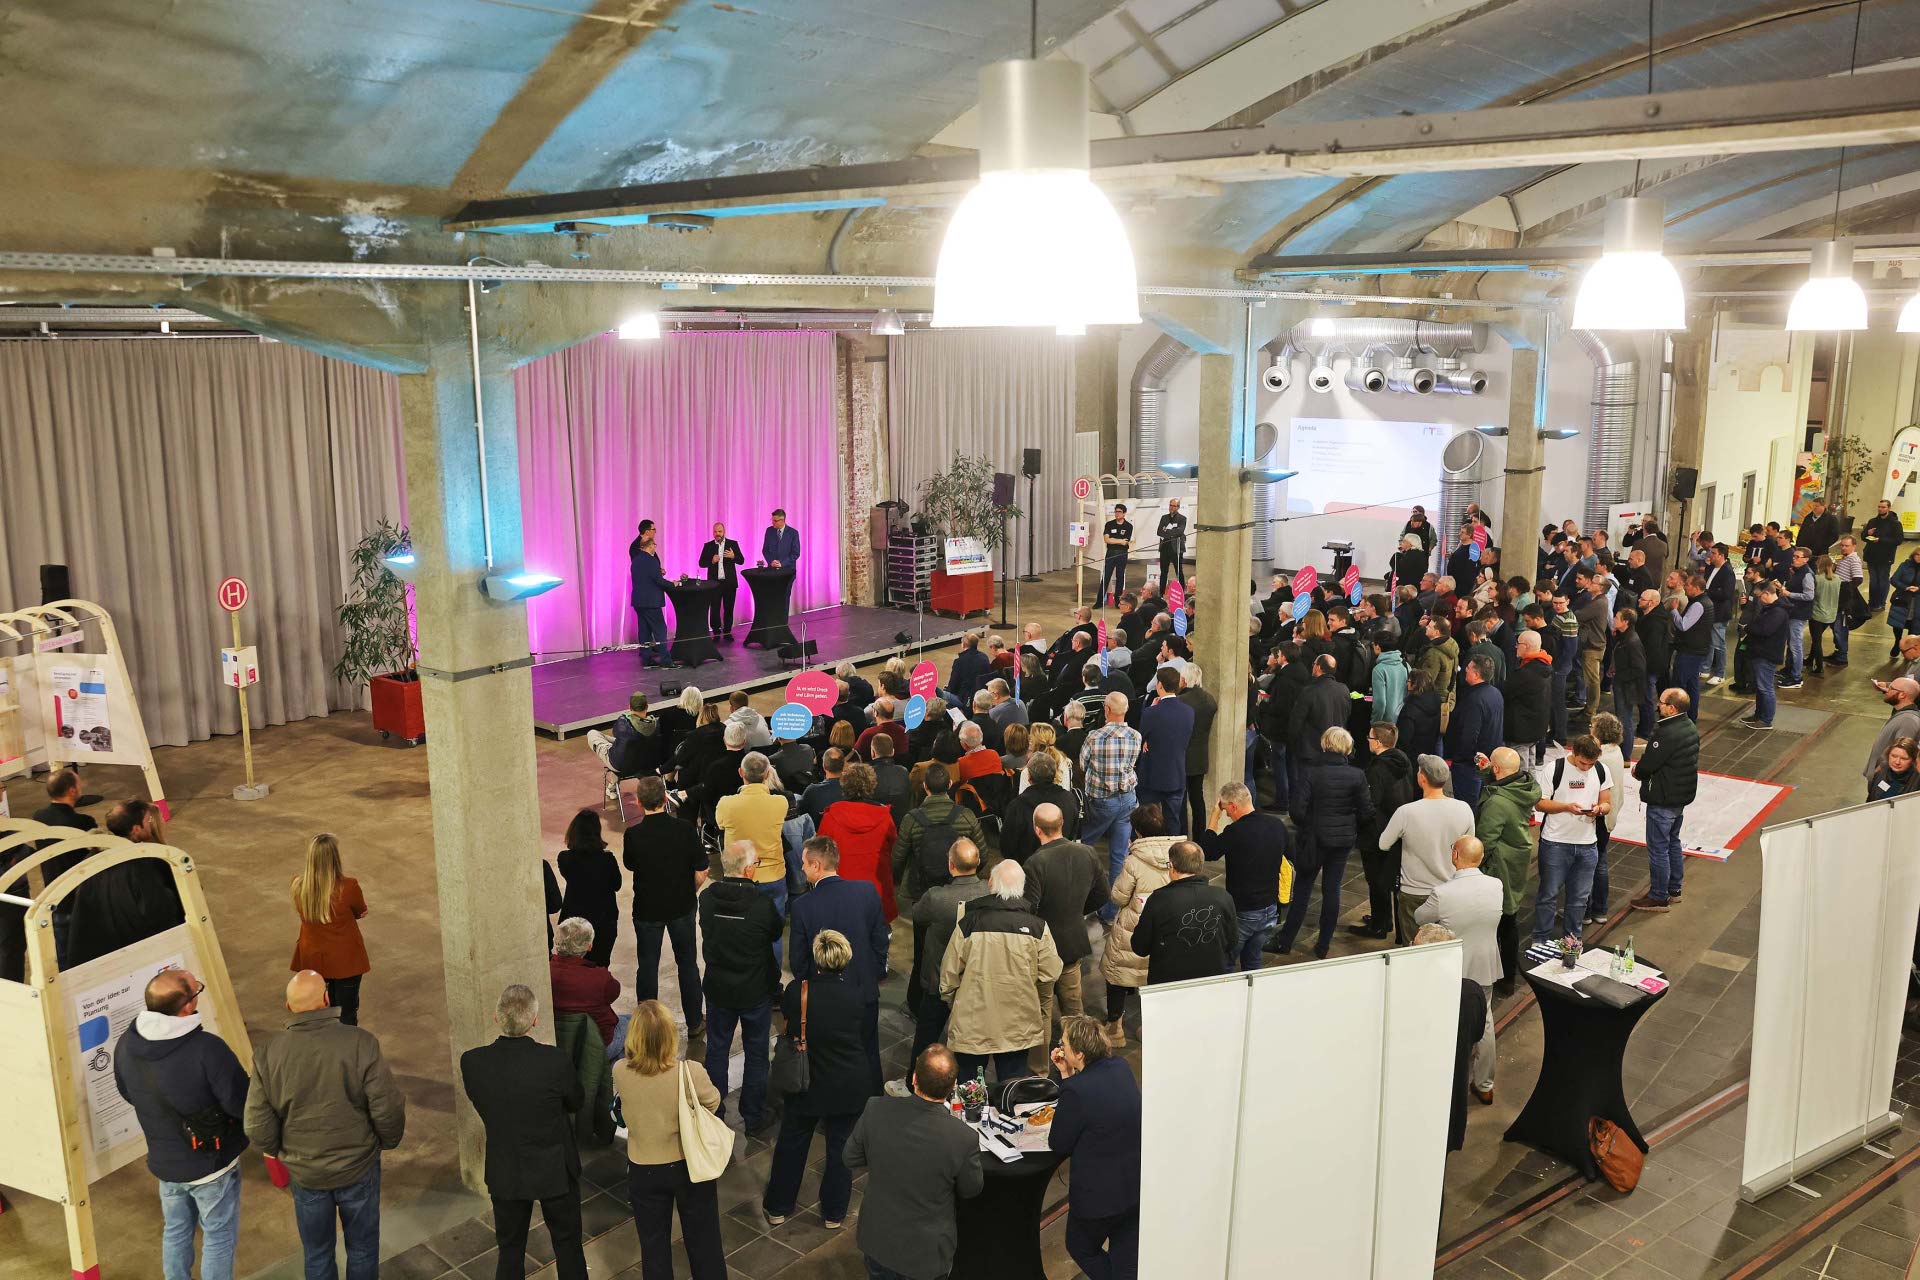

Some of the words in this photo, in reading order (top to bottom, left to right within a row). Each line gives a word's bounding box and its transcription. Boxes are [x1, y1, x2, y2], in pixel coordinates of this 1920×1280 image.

[226, 583, 241, 605] H
[82, 1001, 95, 1010] Von
[96, 997, 106, 1005] der
[83, 1004, 109, 1018] Planung
